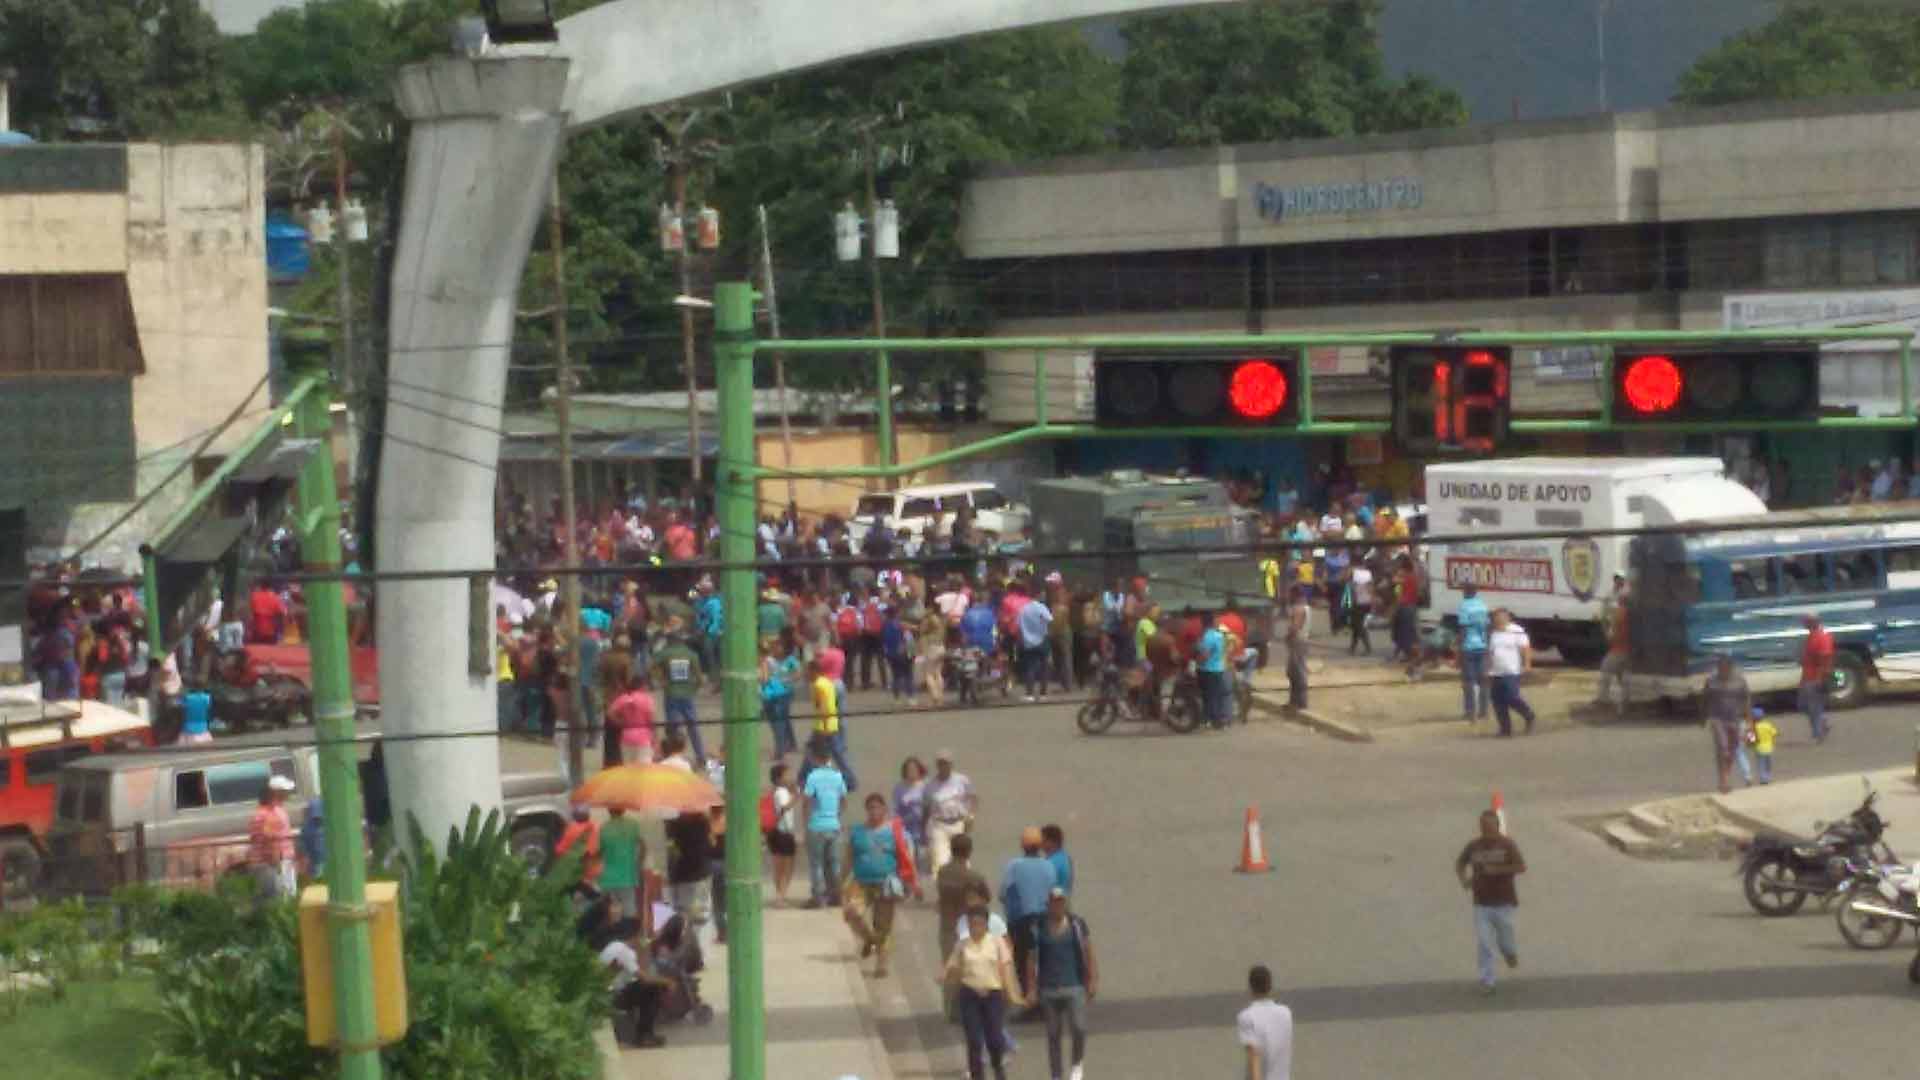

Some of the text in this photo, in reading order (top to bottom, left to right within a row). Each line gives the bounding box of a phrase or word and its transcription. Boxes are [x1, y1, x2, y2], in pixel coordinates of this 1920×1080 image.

[1433, 351, 1507, 452] 12
[1440, 481, 1592, 502] UNIDAD DE APOYO
